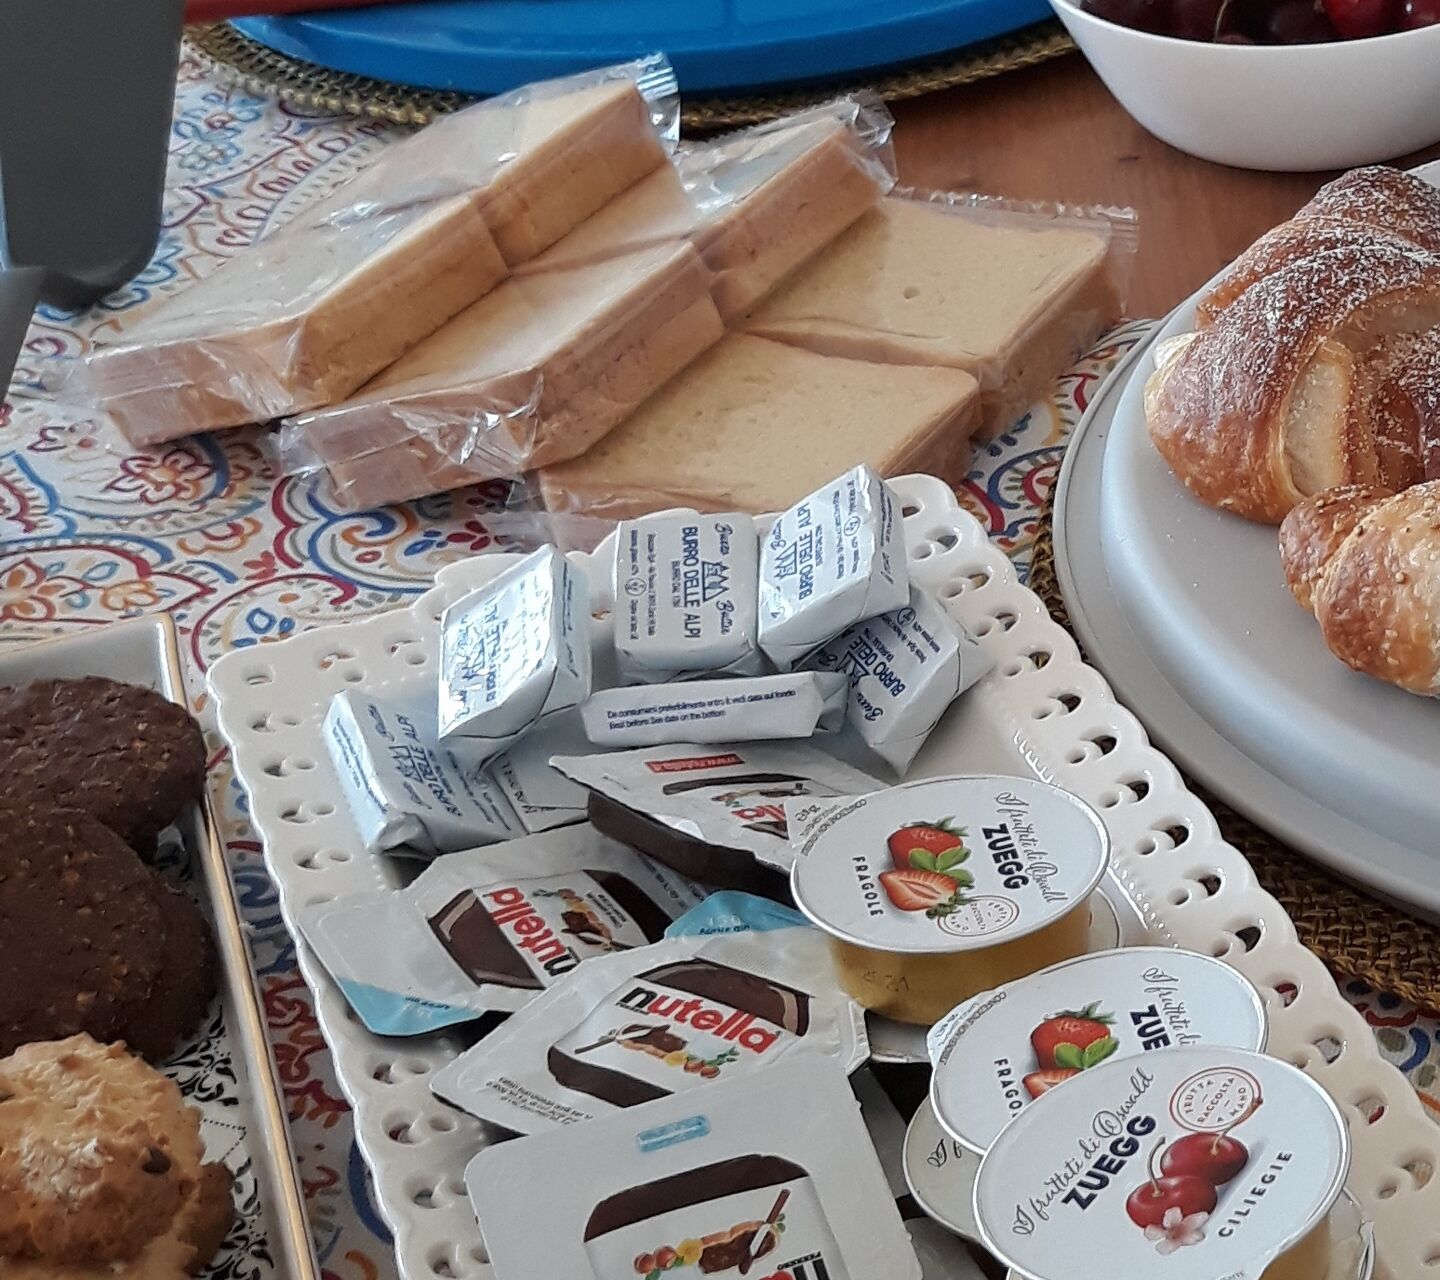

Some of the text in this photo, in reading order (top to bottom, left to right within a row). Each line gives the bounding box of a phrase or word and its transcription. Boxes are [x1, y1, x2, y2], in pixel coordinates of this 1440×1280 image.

[797, 502, 811, 528] ALPI
[682, 527, 701, 639] BURRO DELLE ALPI
[872, 661, 906, 697] BURRO
[852, 856, 884, 917] FRAGOLE
[982, 823, 1029, 890] ZUEGG
[489, 886, 581, 976] nutella
[620, 986, 781, 1055] nutella
[1129, 1004, 1172, 1052] ZUE
[993, 1058, 1024, 1119] FRAGO
[1196, 1076, 1236, 1124] RACCOLTA
[1061, 1114, 1157, 1211] ZUEGG
[1083, 1136, 1101, 1160] di
[1217, 1151, 1293, 1238] CILIEGIE
